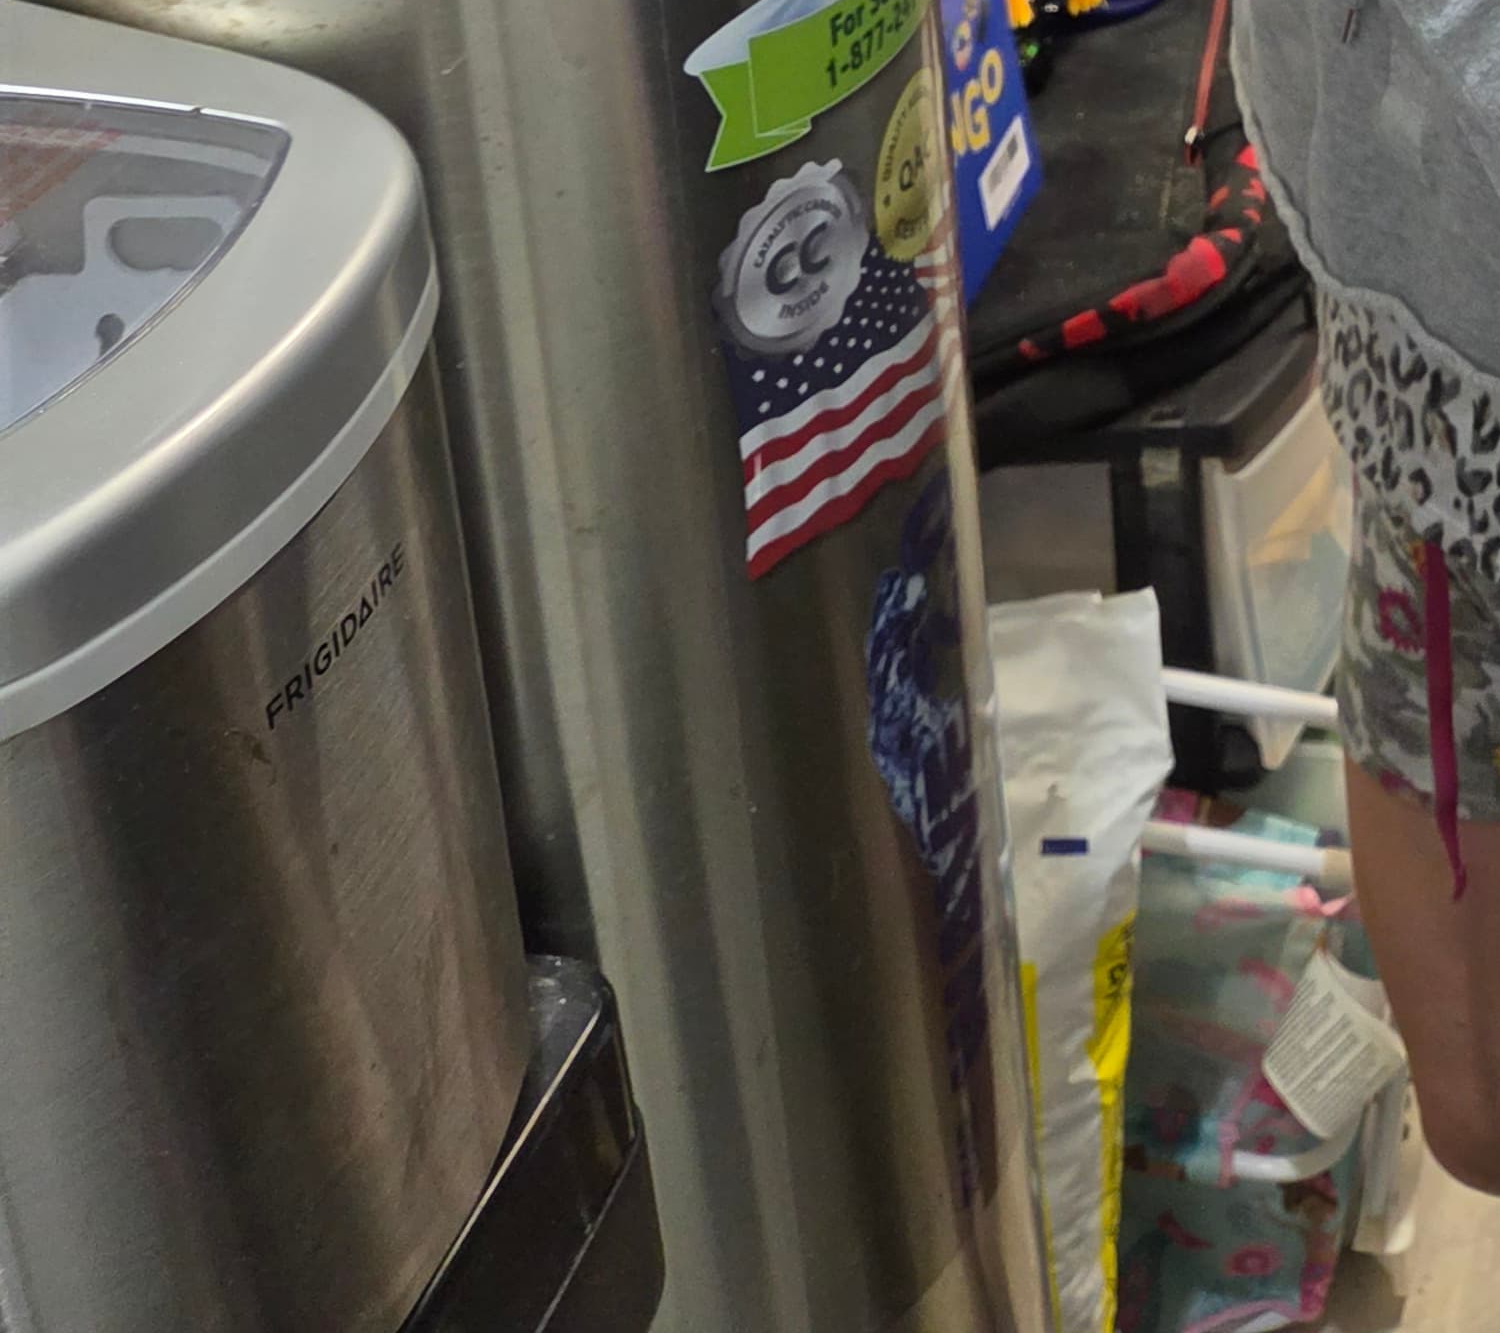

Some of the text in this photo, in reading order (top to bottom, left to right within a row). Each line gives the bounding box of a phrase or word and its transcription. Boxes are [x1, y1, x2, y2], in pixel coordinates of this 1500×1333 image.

[829, 3, 865, 47] For
[765, 220, 831, 296] CC
[265, 541, 405, 731] FRIGIDAIRE
